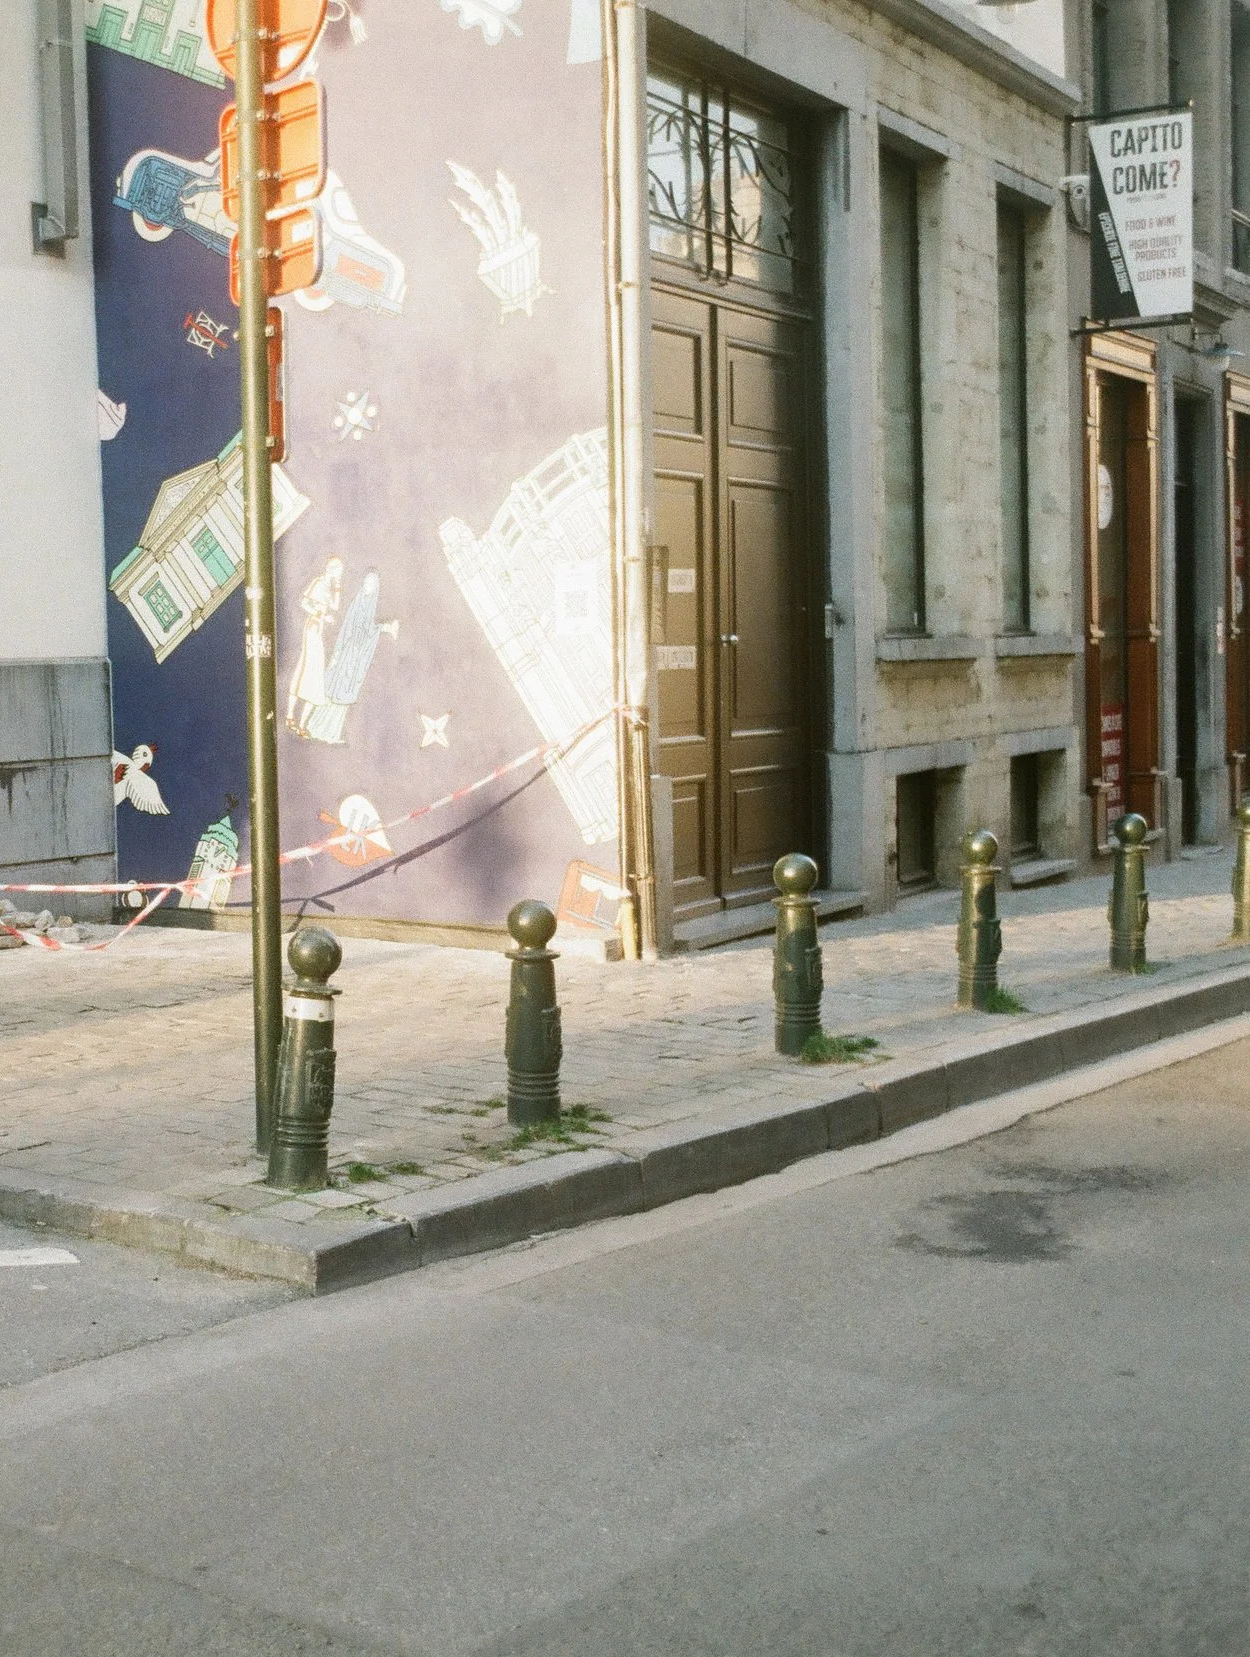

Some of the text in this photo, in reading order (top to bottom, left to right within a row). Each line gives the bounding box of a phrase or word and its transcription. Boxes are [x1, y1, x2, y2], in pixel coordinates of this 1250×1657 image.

[1110, 121, 1183, 158] CAPITO
[1112, 159, 1181, 195] COME?
[1124, 219, 1147, 231] FOOD
